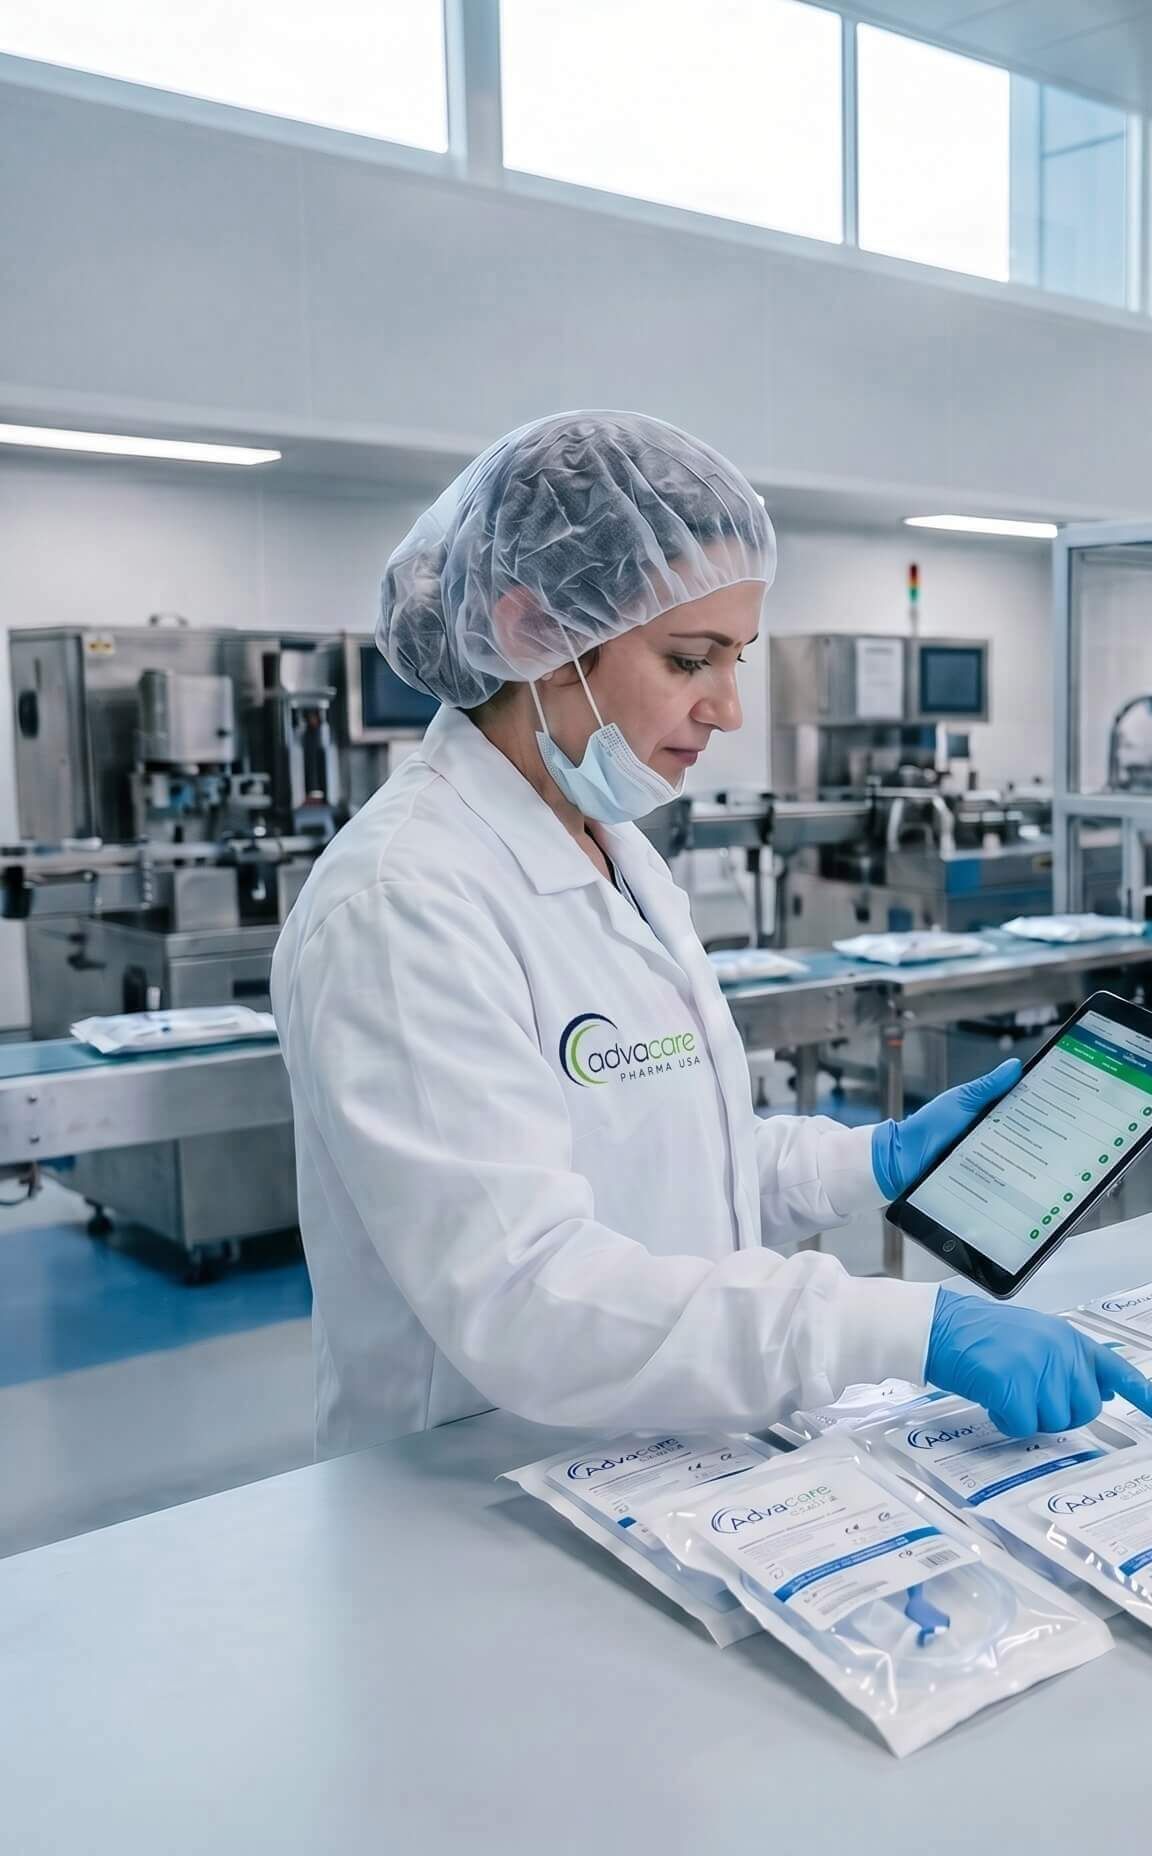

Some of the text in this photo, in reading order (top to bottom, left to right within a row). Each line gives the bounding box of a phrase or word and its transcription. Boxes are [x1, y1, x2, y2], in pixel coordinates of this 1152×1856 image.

[588, 1032, 696, 1073] advacare
[620, 1056, 701, 1082] PHARMA USA
